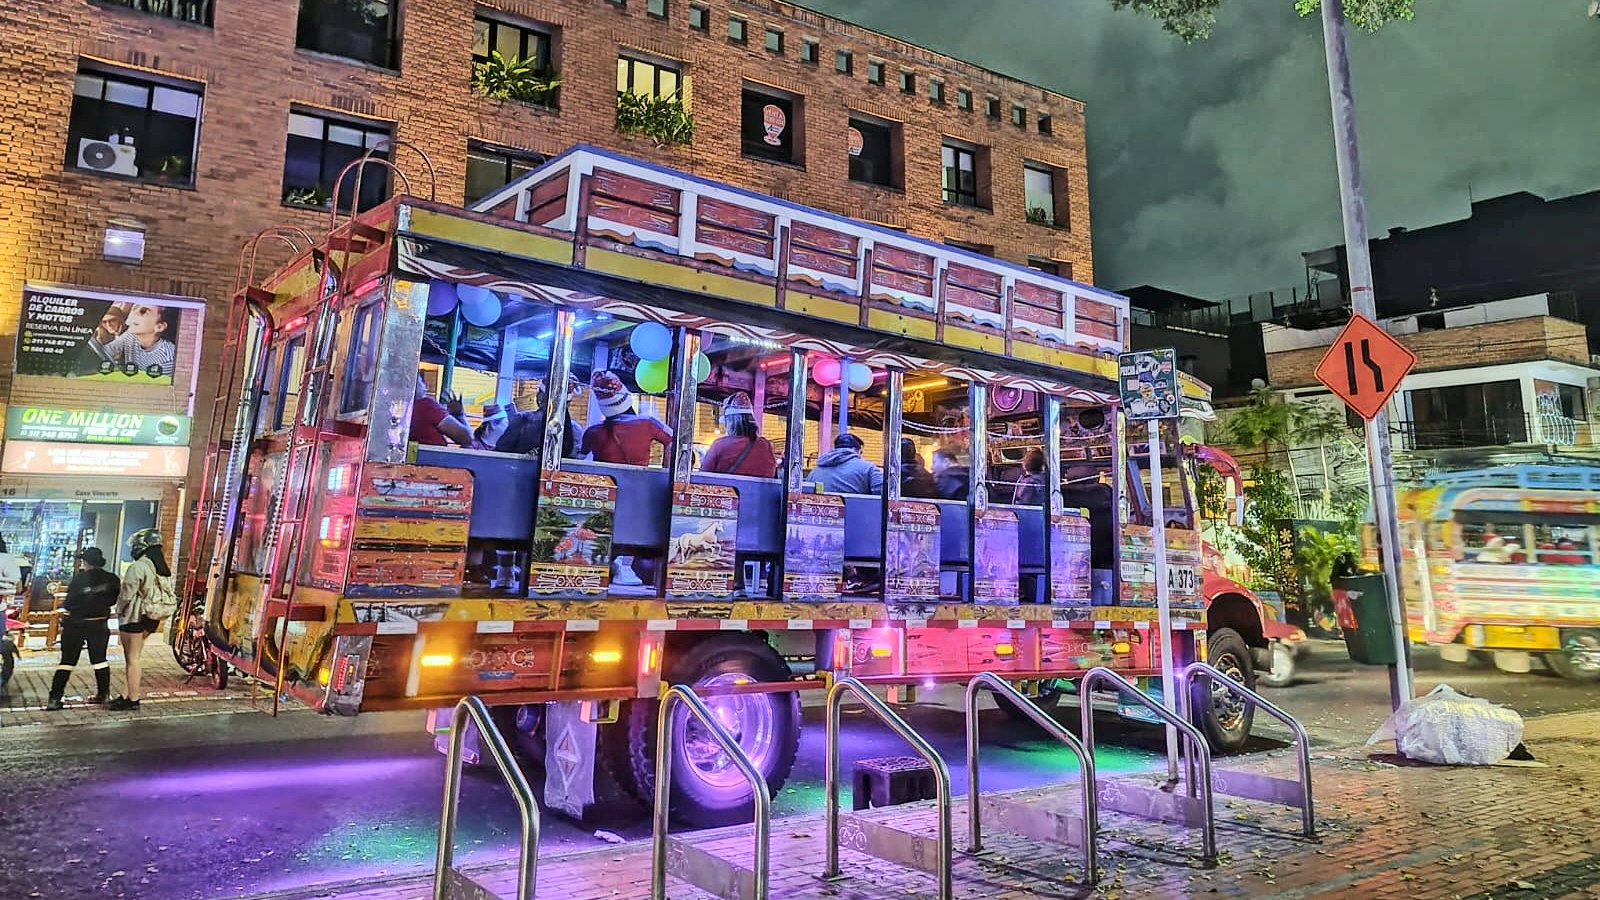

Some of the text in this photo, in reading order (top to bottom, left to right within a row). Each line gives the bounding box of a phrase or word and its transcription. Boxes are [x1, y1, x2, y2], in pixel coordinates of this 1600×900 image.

[29, 295, 78, 306] ALQUILER
[44, 305, 85, 315] CARROS
[28, 312, 74, 323] Y MOTOS
[25, 322, 58, 332] RESERVA
[59, 325, 71, 333] EN
[22, 408, 64, 425] ONE
[1178, 569, 1194, 588] 373
